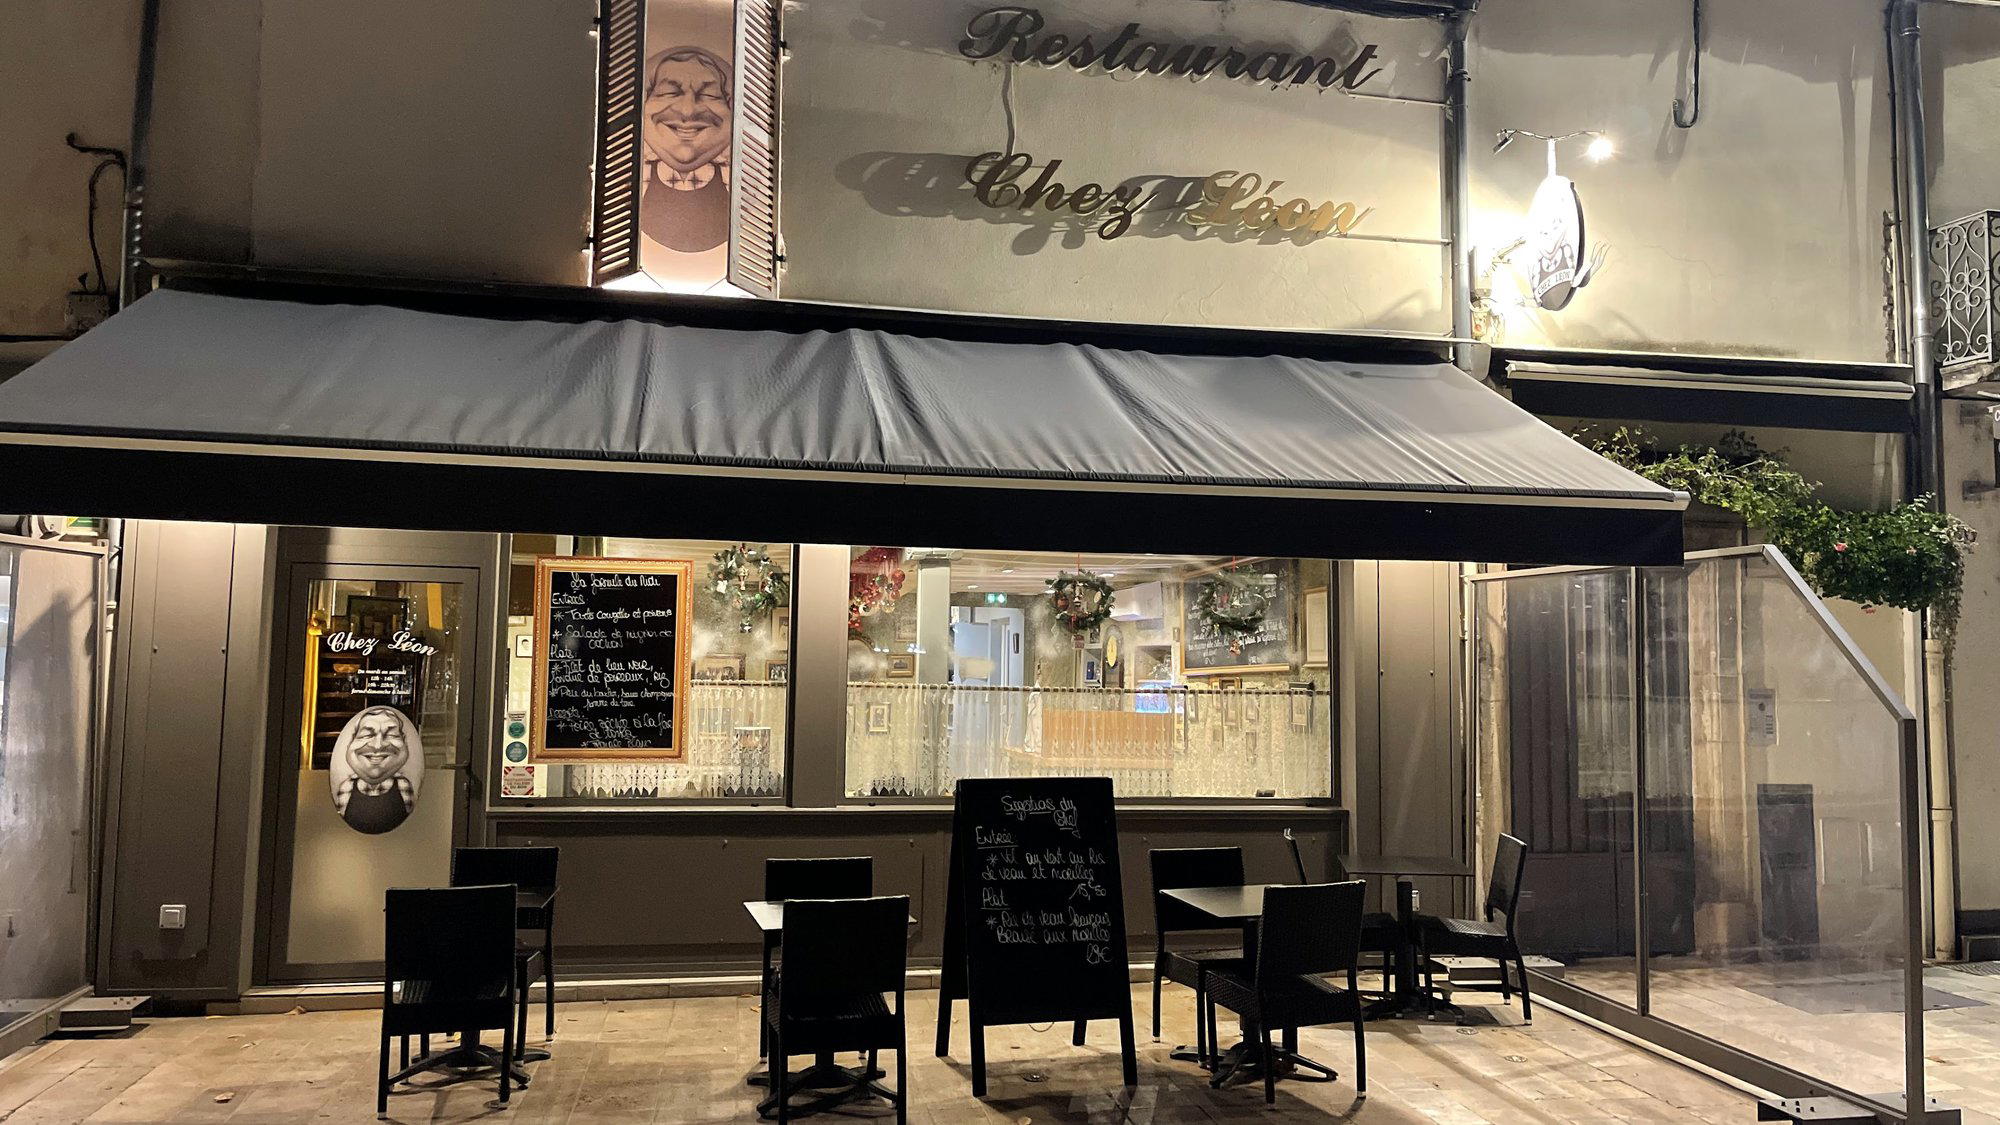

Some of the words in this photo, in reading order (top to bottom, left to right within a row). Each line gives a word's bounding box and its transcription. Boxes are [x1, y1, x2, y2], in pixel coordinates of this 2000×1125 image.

[959, 6, 1382, 91] Restaurant
[964, 151, 1158, 240] Chez
[1188, 170, 1374, 235] Léon
[625, 575, 638, 587] du
[632, 608, 642, 618] et
[565, 624, 607, 639] Salade
[611, 629, 622, 641] de
[327, 631, 380, 656] Chez
[388, 630, 439, 656] Léon
[589, 659, 602, 673] de
[587, 672, 600, 684] de
[1059, 797, 1074, 811] du
[1025, 852, 1040, 866] au
[1069, 852, 1085, 864] au
[1032, 865, 1046, 879] et
